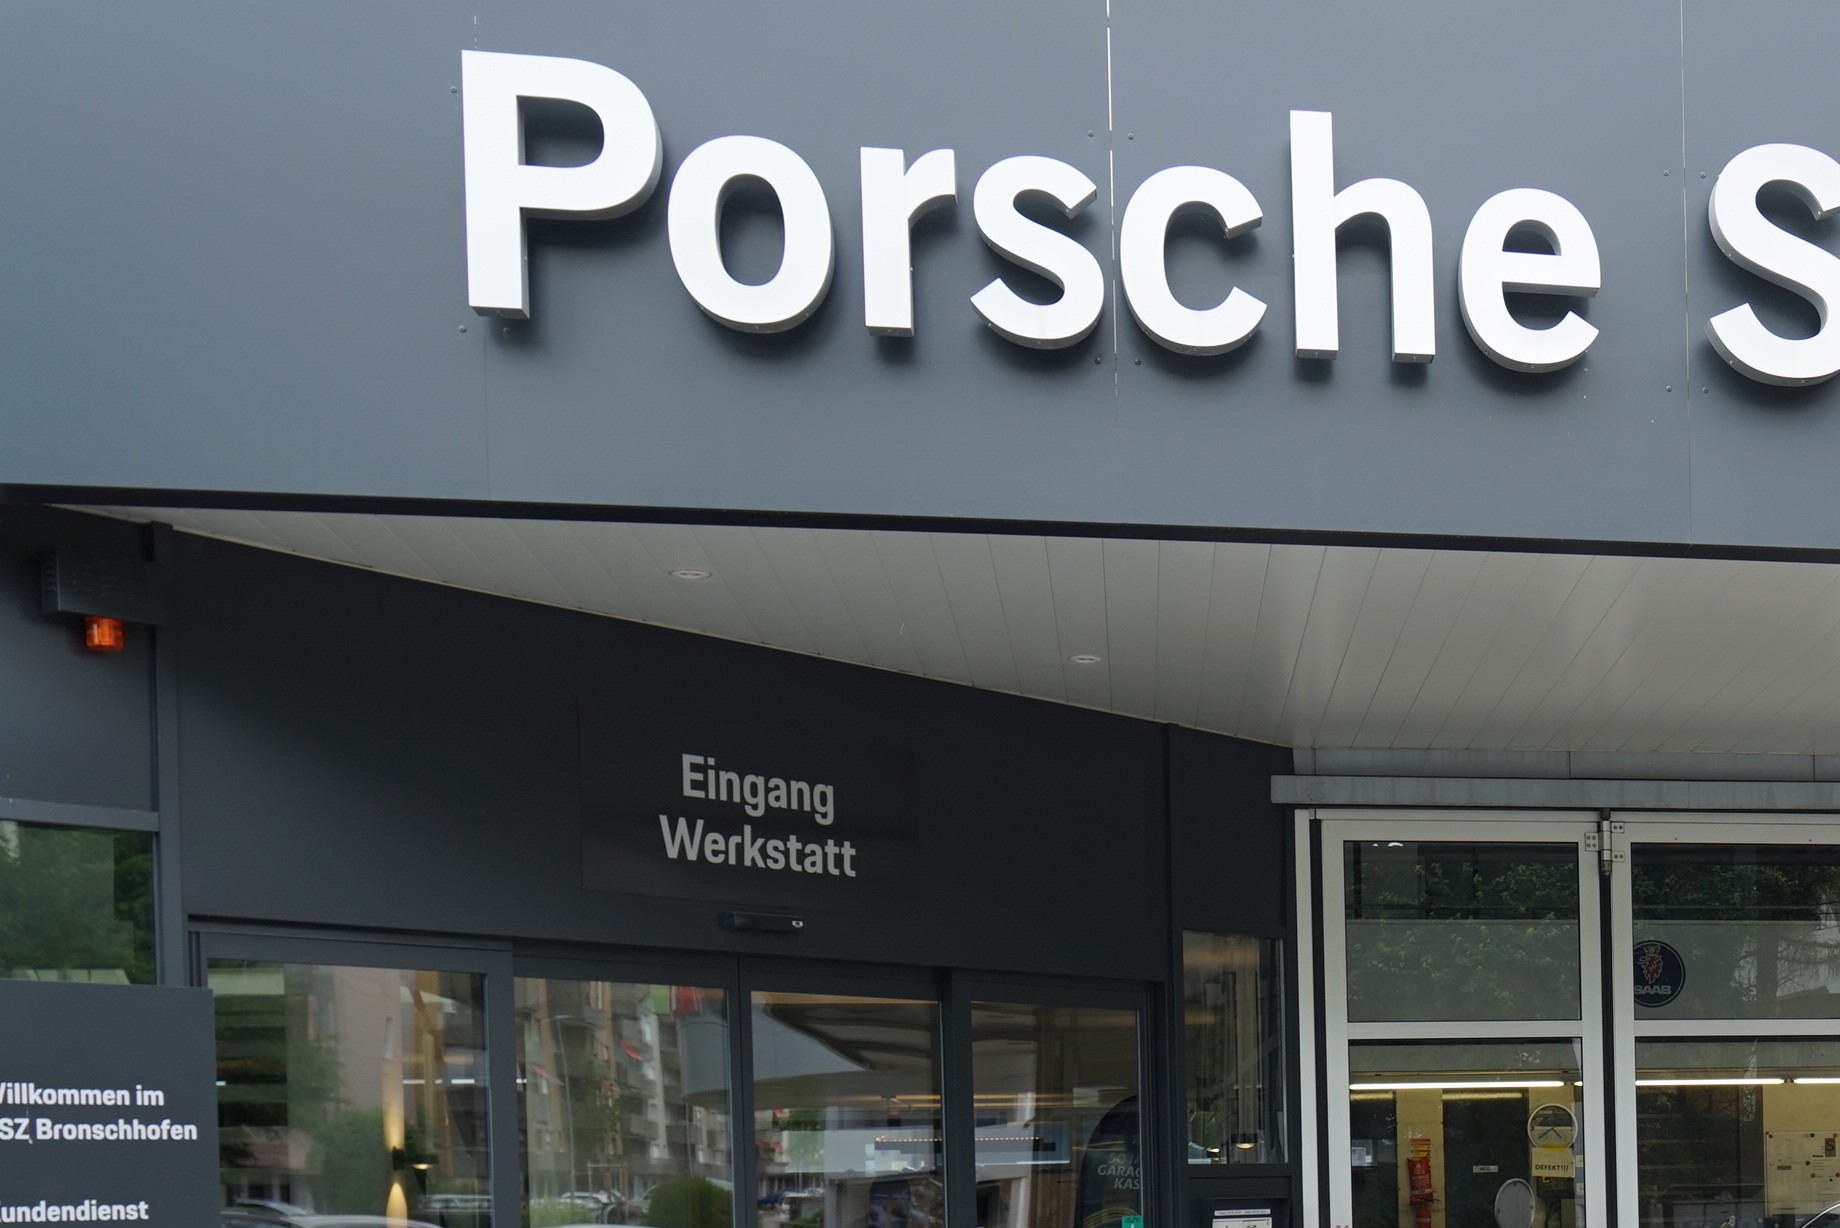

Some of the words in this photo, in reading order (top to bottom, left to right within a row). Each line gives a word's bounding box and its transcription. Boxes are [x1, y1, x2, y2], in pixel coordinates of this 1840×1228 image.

[461, 49, 1601, 373] Porsche
[681, 753, 835, 826] Eingang
[658, 814, 857, 878] Werkstatt
[1634, 985, 1672, 995] SAAB
[135, 1084, 165, 1106] im
[36, 1118, 198, 1141] Bronschhofen
